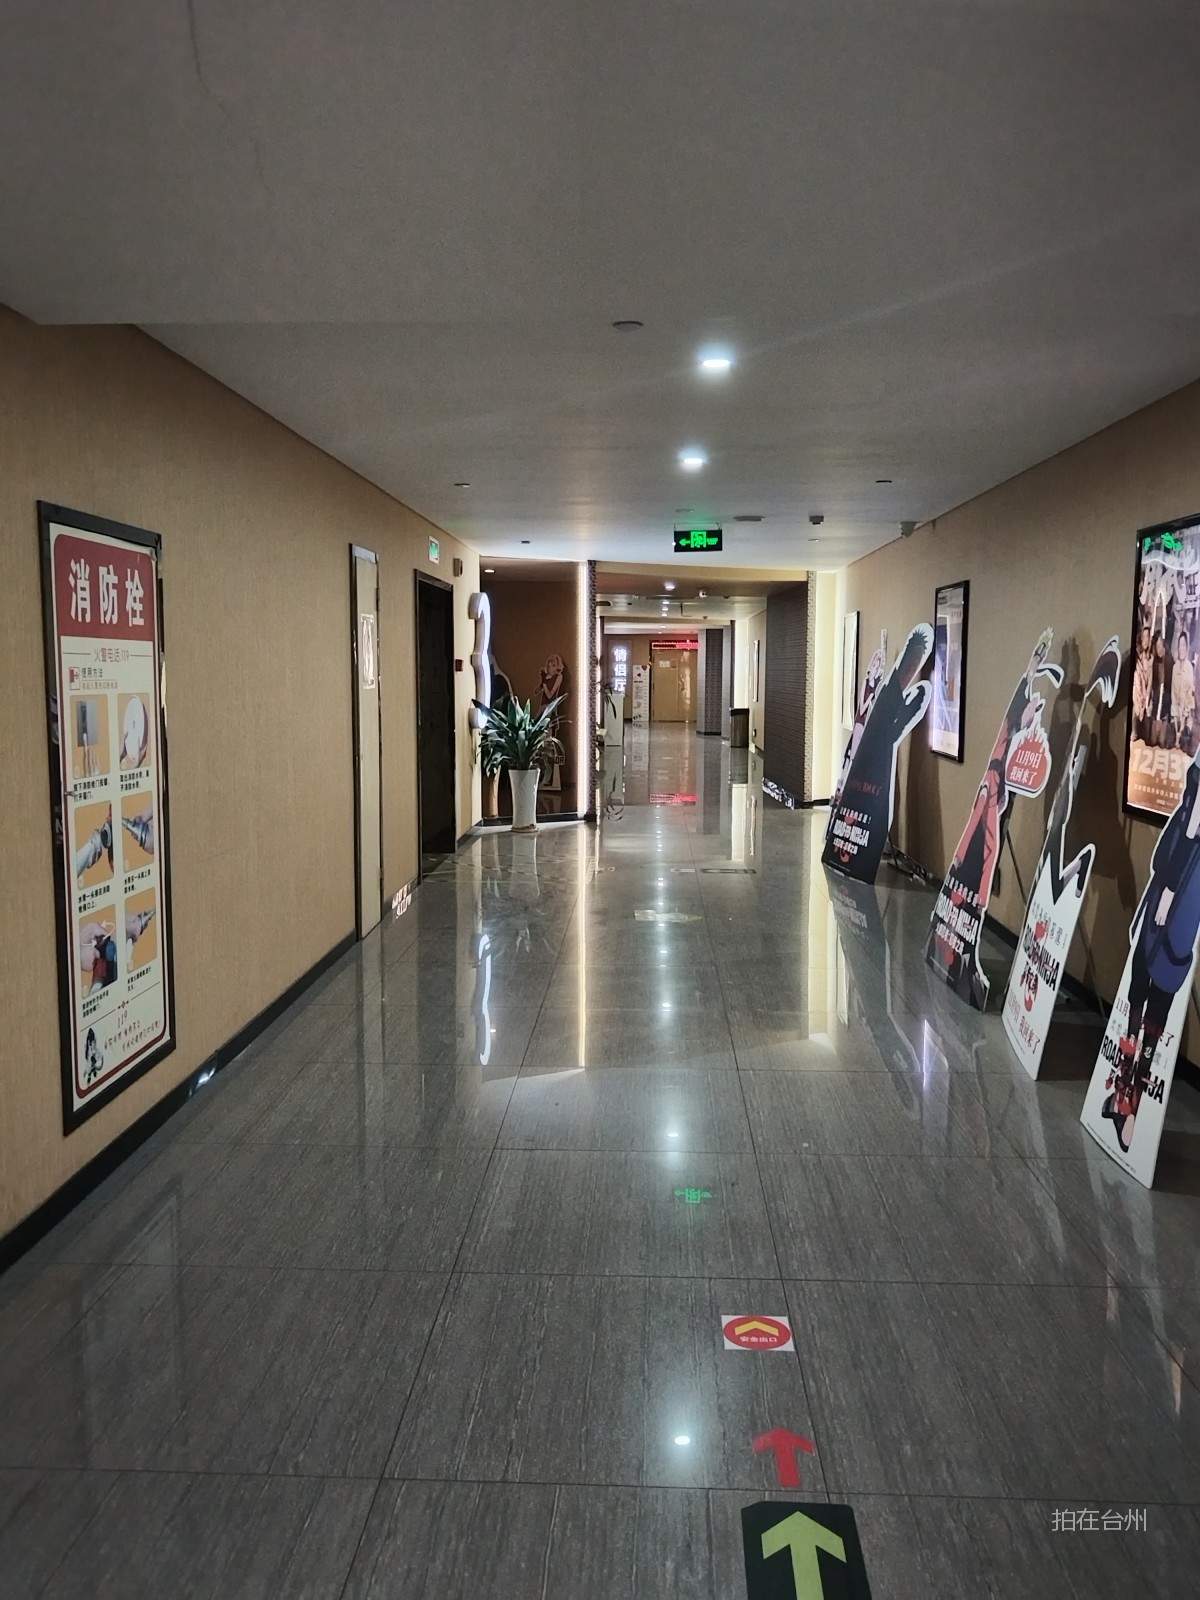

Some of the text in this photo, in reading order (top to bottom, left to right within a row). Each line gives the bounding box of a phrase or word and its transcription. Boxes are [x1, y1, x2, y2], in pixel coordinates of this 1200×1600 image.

[68, 558, 145, 627] 消防栓
[1016, 749, 1043, 769] 11月9日
[1101, 1035, 1121, 1068] ROAD
